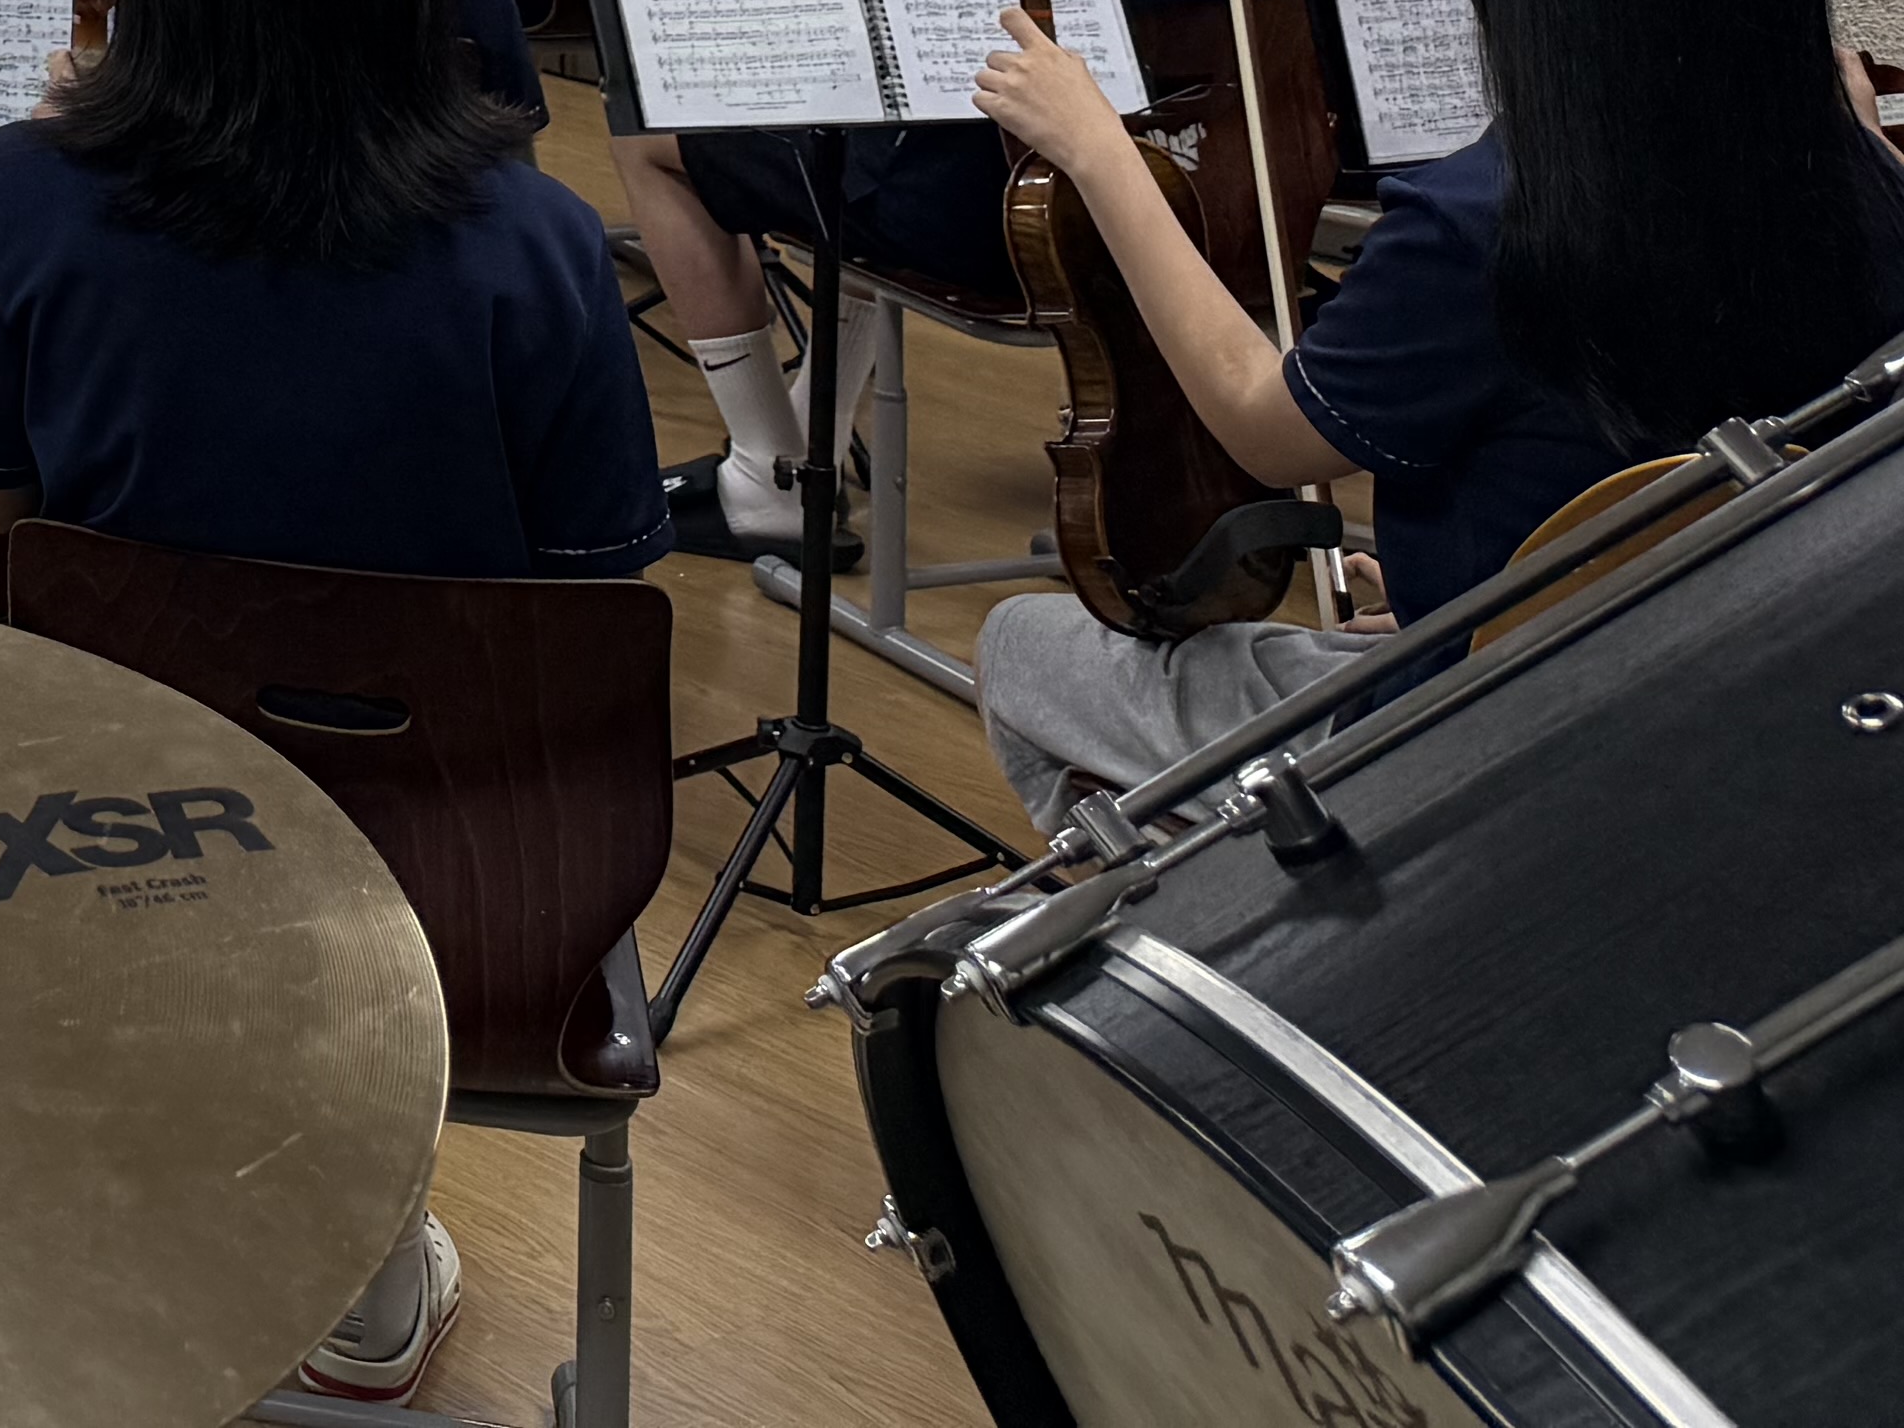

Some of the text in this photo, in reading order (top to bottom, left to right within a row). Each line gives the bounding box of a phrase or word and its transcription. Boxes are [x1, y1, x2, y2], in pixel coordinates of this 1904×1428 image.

[97, 873, 207, 897] Fast Crash
[178, 890, 209, 902] cm
